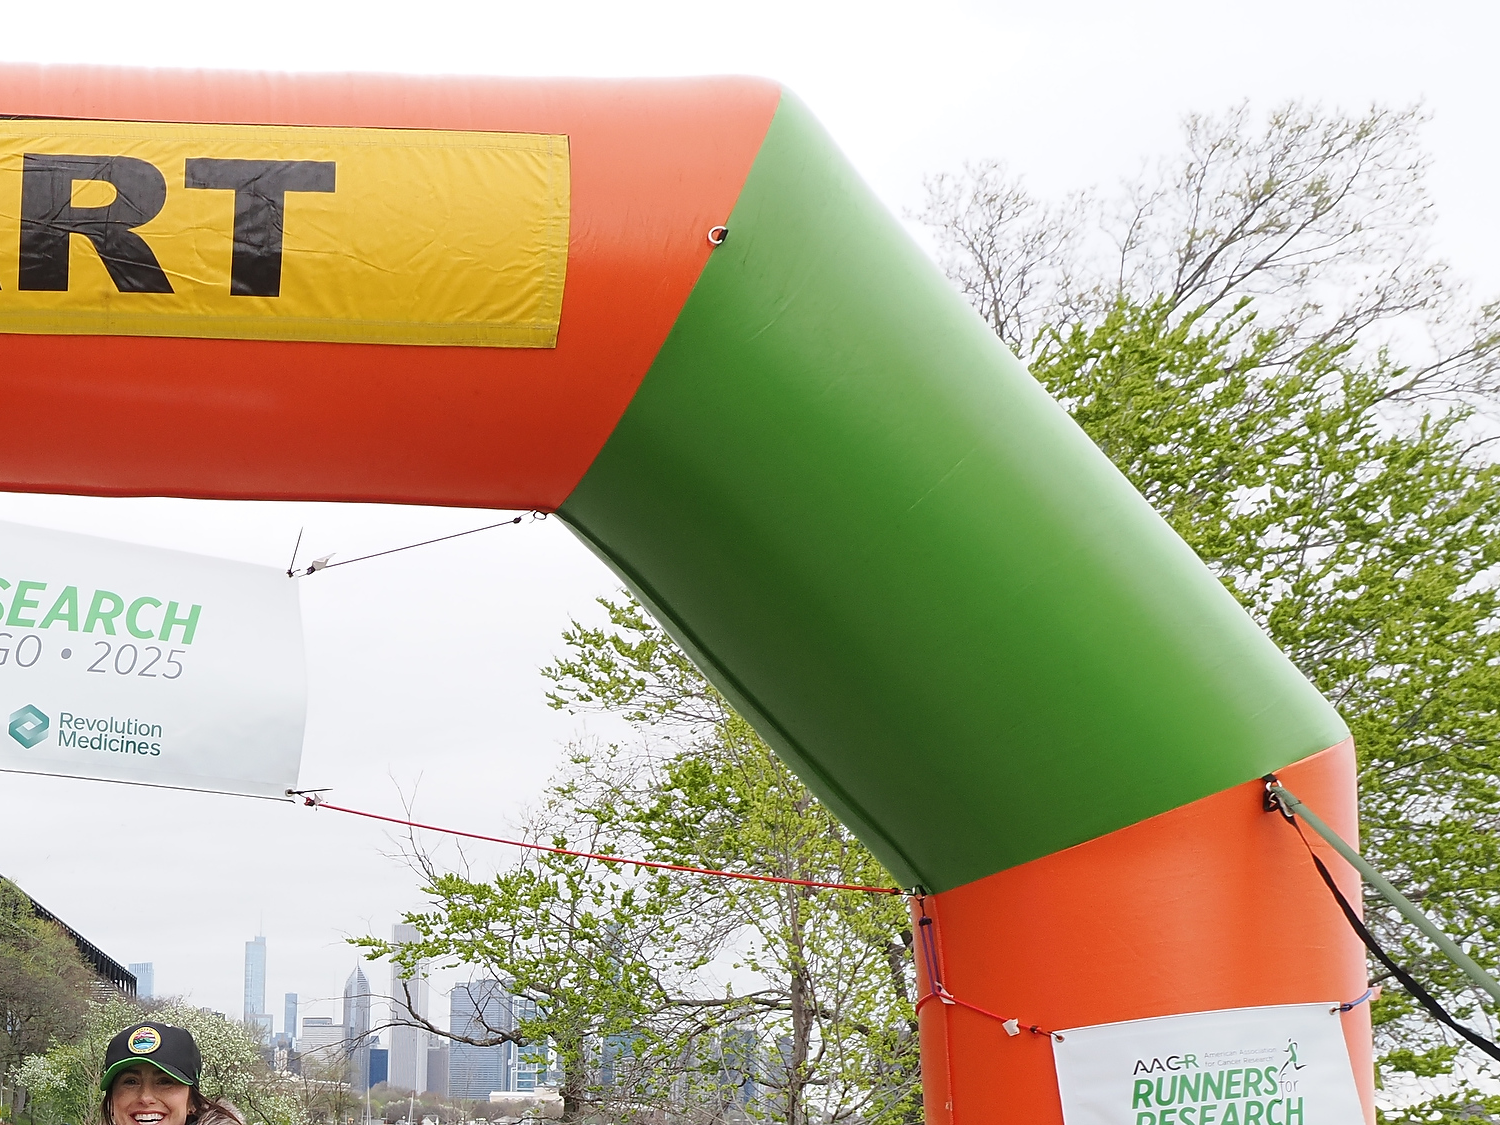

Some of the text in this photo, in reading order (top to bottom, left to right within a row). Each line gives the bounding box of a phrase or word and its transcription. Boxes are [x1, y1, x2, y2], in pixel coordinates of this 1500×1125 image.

[87, 641, 186, 679] 2025
[60, 712, 162, 738] Revolution
[58, 730, 161, 756] Medicines
[1133, 1054, 1199, 1075] AACR
[1204, 1047, 1277, 1059] American Association
[1217, 1058, 1241, 1067] Cancer
[1132, 1066, 1299, 1109] RUNNERS for
